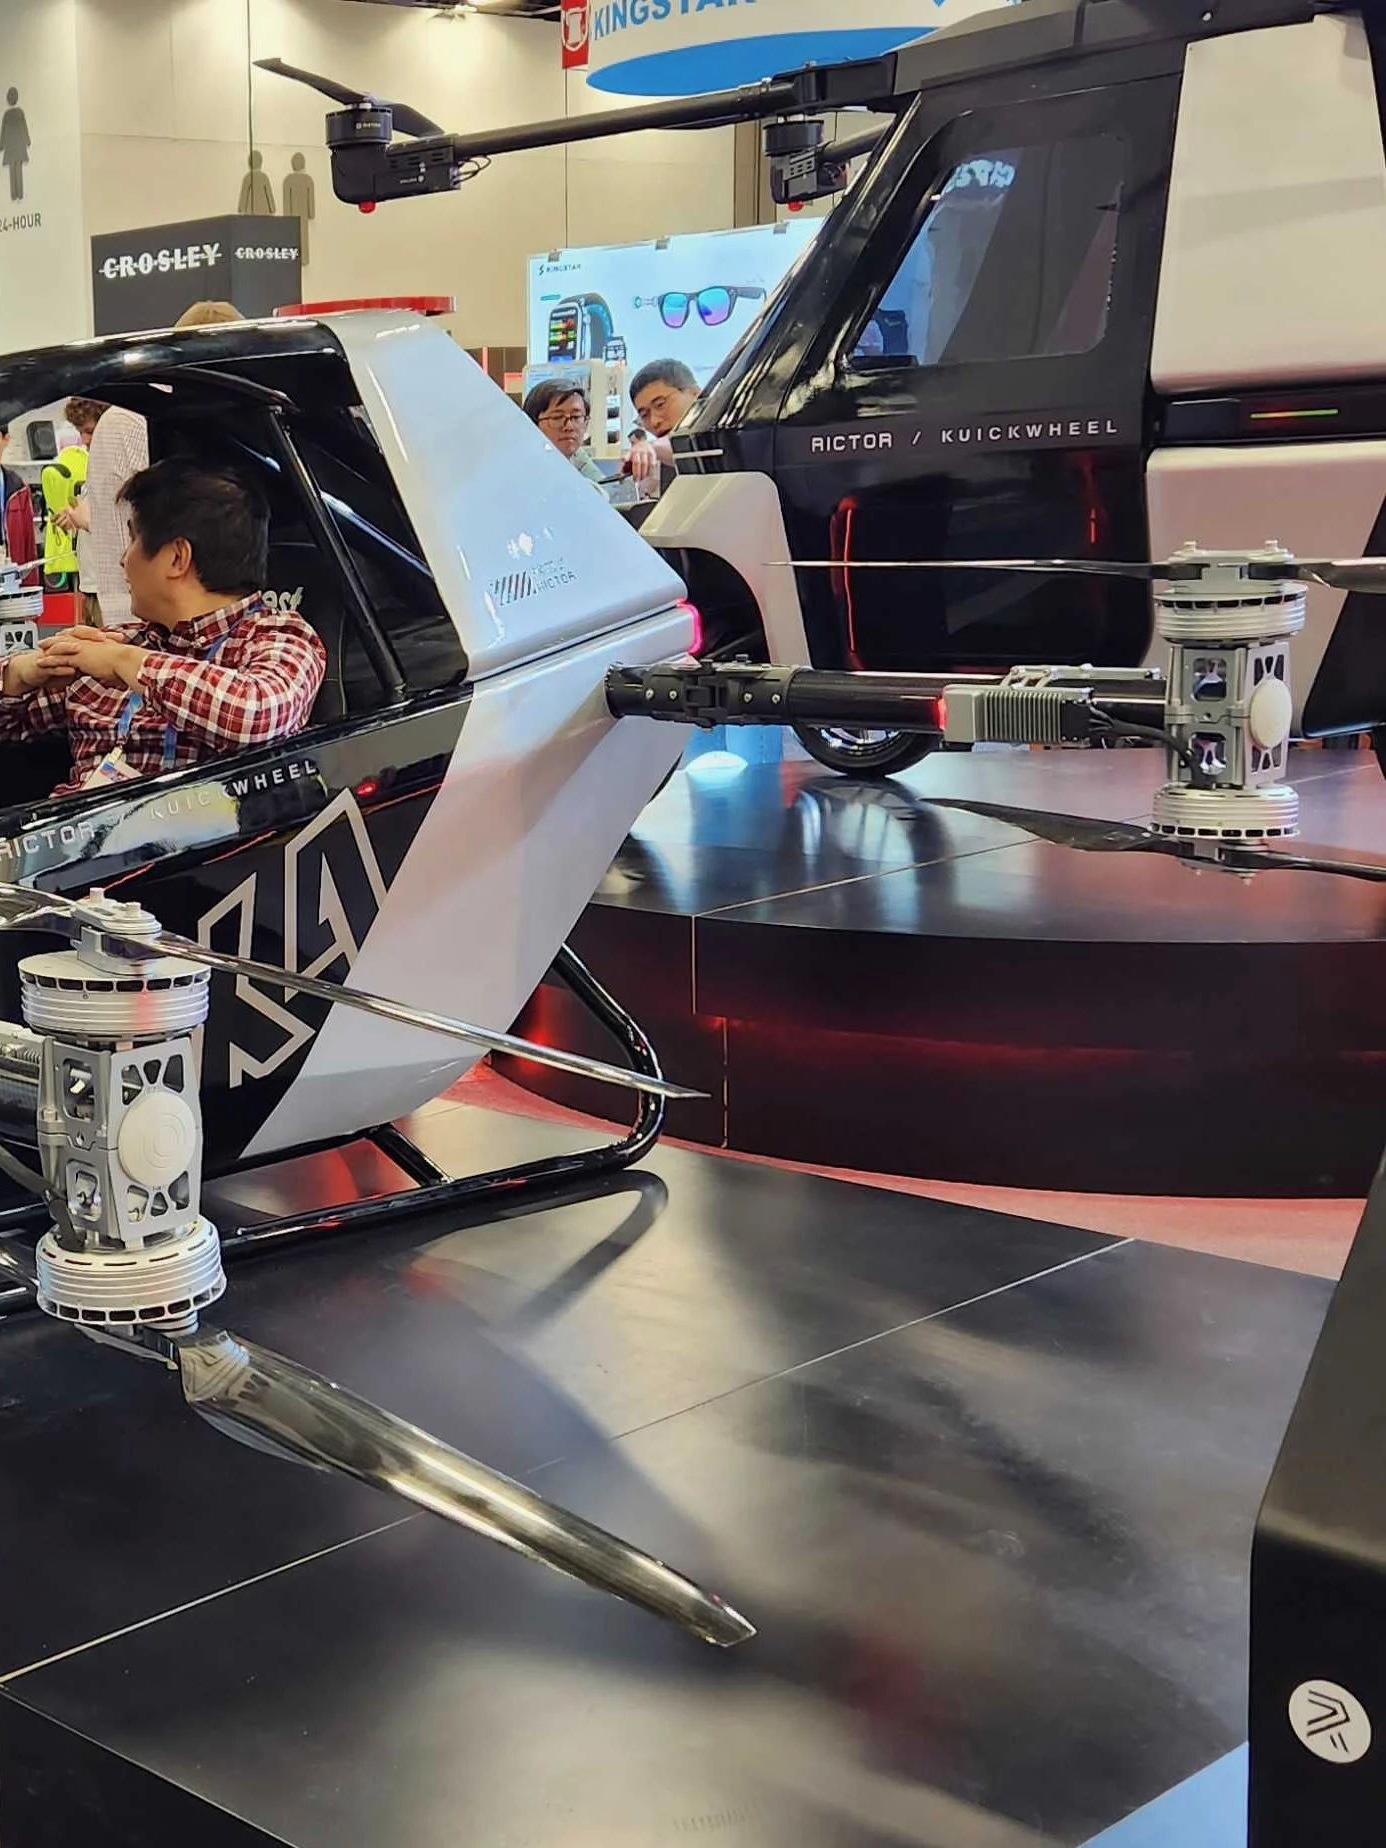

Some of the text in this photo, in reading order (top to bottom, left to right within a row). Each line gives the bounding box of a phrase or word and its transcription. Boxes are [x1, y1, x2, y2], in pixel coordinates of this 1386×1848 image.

[594, 0, 757, 40] KINGS
[99, 243, 222, 279] CROSLEY
[234, 247, 299, 260] CROSLEY
[810, 432, 893, 453] RICTOR
[941, 420, 1119, 444] KUICKWHEEL
